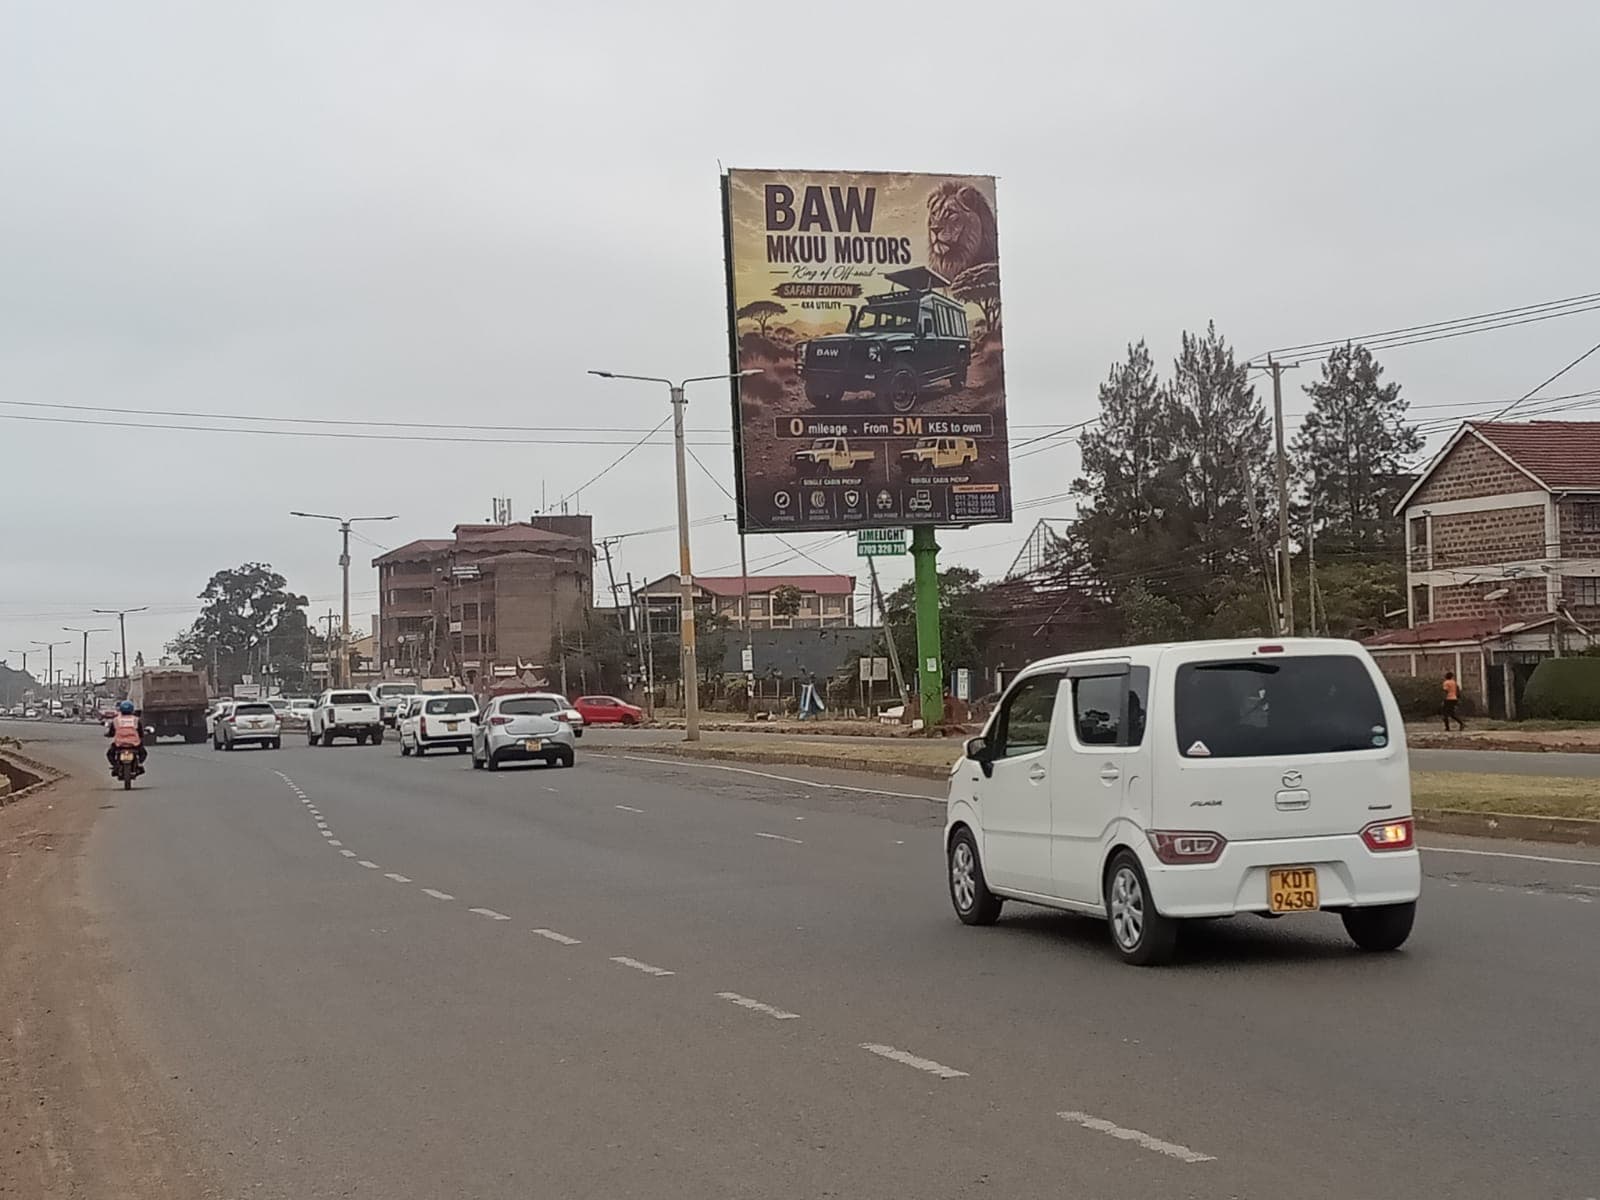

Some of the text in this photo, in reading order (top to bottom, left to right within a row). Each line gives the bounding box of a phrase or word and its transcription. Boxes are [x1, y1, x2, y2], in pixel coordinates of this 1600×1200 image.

[765, 184, 876, 233] BAW
[766, 235, 912, 265] MKUU MOTORS
[792, 265, 818, 280] King
[820, 266, 833, 280] of
[783, 285, 854, 297] SAFARI EDITION
[816, 301, 842, 310] UTILITY
[816, 348, 839, 357] BAW
[789, 417, 982, 436] 0 mileage From 5M KES to own
[803, 478, 822, 486] SINGLE
[824, 478, 840, 486] CABIN
[858, 529, 905, 541] LIMELIGHT
[858, 544, 877, 555] 0703
[1281, 871, 1313, 889] KDT
[1274, 890, 1315, 910] 943Q
